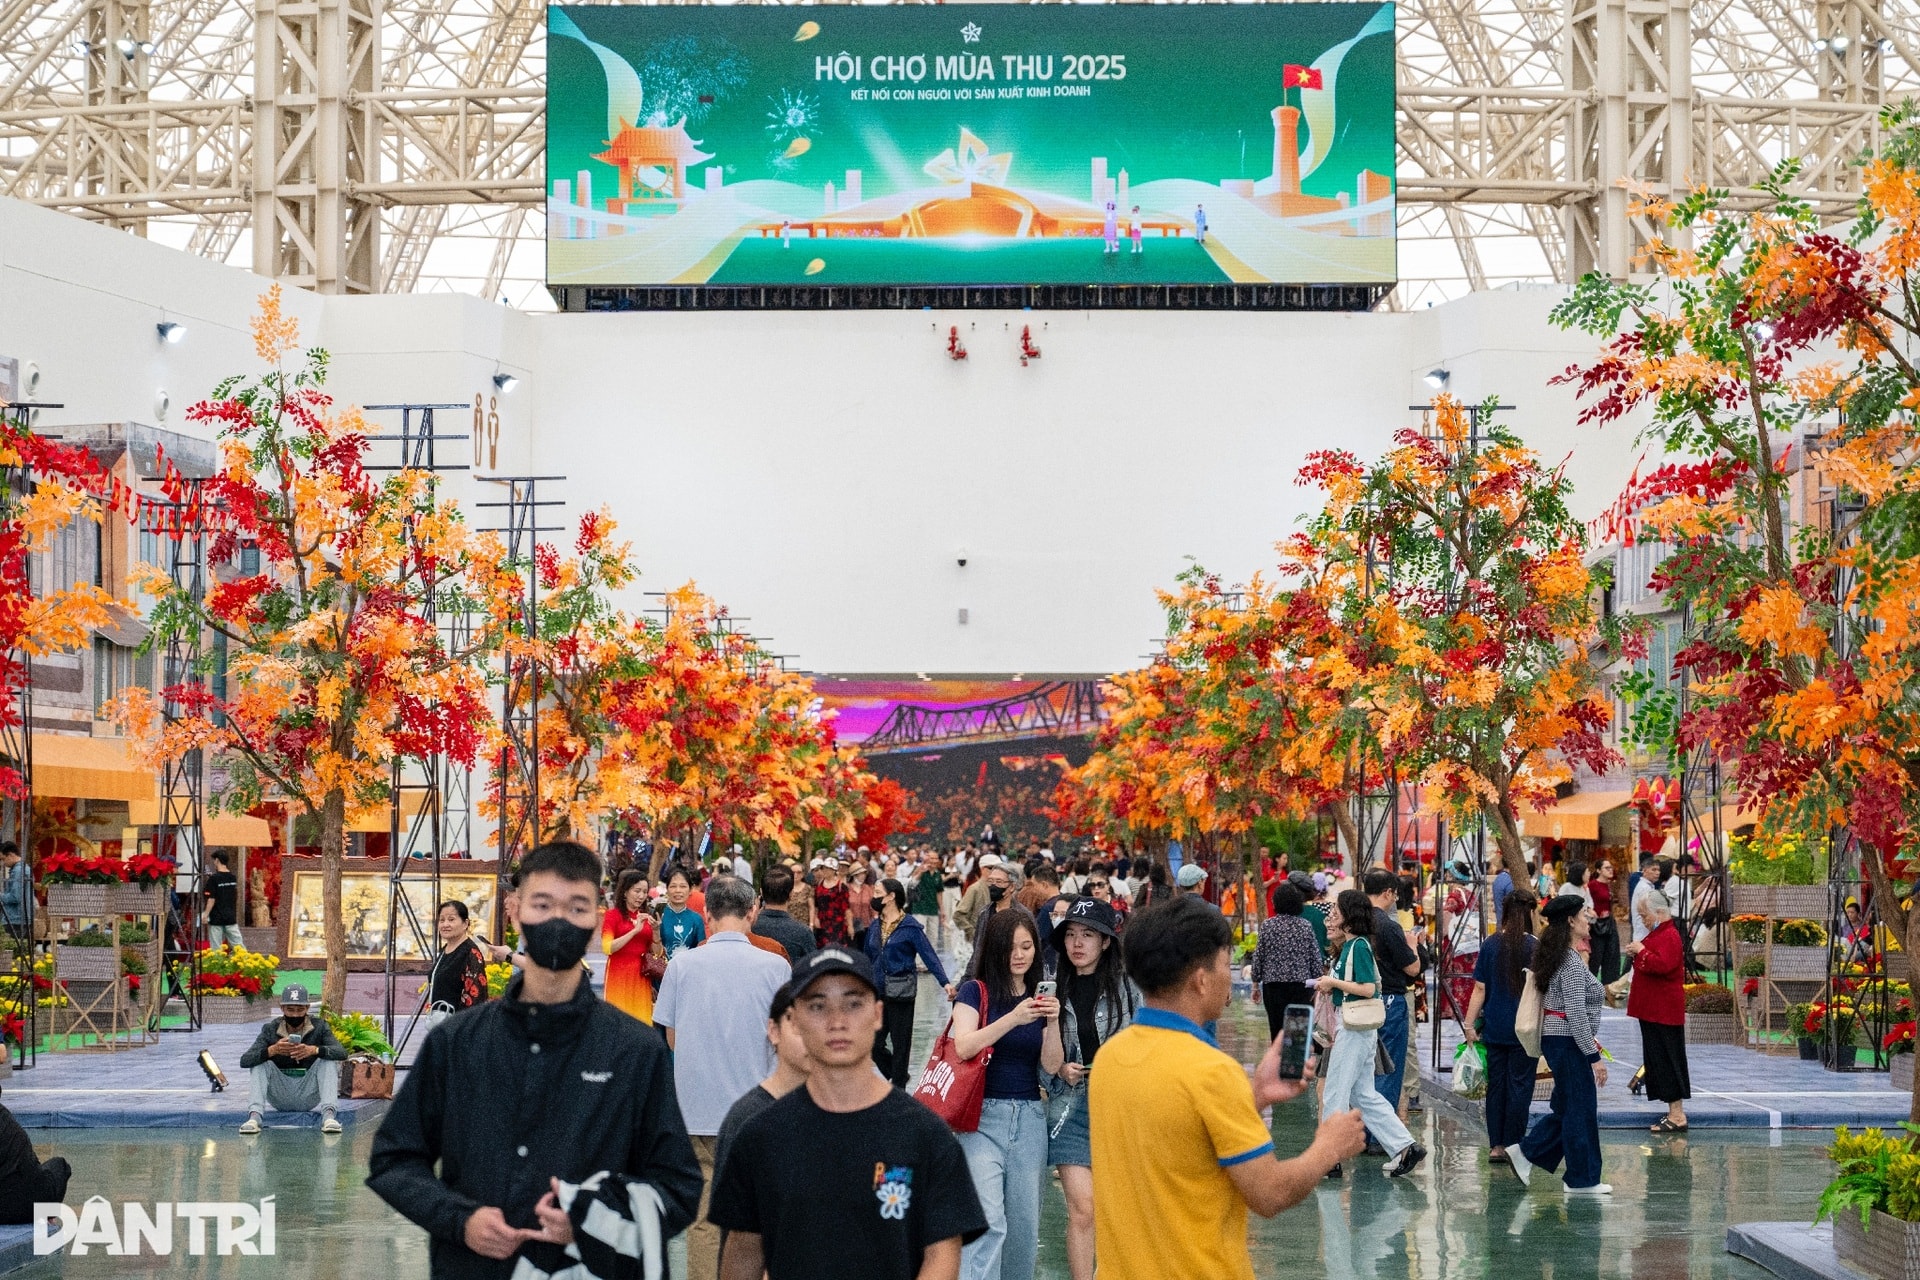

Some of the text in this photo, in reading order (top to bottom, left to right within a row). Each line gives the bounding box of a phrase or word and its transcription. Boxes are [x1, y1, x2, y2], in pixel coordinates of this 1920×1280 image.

[815, 51, 1127, 83] HỘI CHỢ MÙA THU 2025
[851, 87, 869, 100] KẾT
[871, 87, 890, 100] NỐI
[893, 89, 914, 100] CON
[1026, 87, 1051, 98] KINH
[1053, 85, 1091, 97] DOANH
